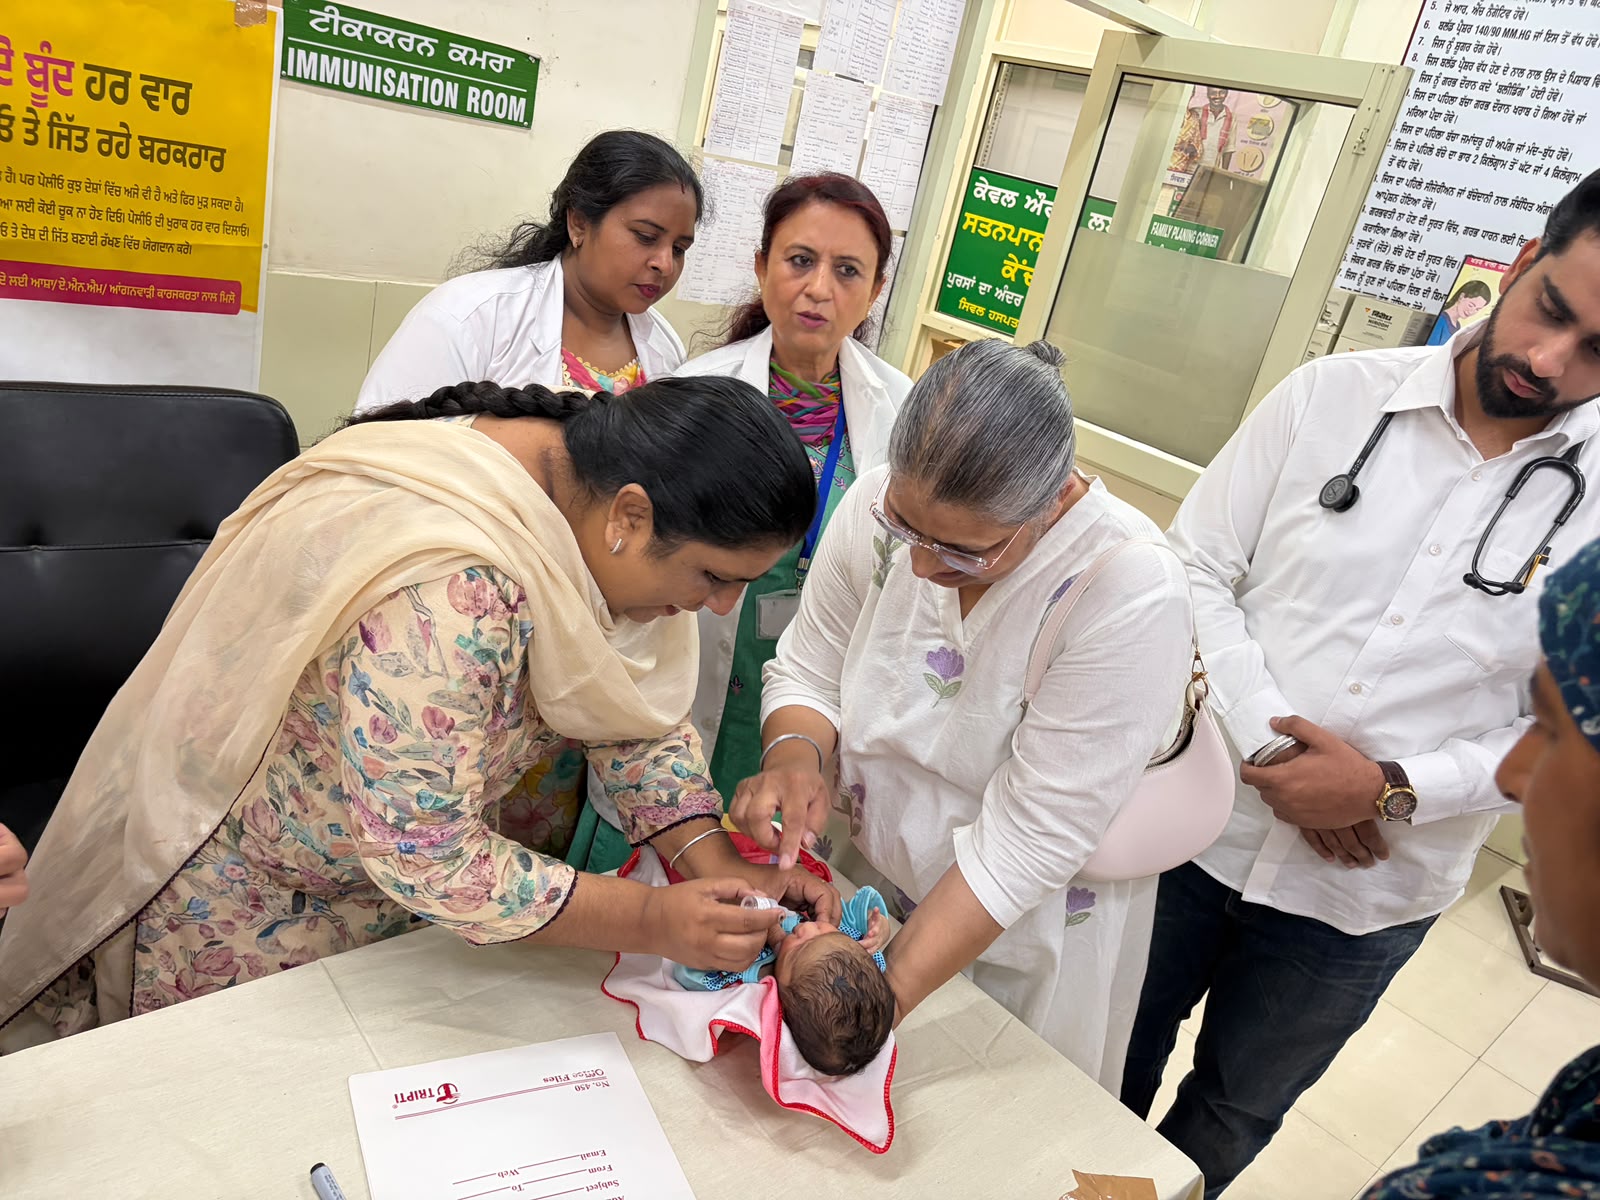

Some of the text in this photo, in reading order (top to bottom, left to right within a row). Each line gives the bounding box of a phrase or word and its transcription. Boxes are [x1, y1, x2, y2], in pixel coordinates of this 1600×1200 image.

[1430, 0, 1438, 11] 5.
[309, 5, 515, 73] ਟੀਕਾਕਰਨ ਕਮਰਾ
[1417, 36, 1425, 46] 7.
[1423, 19, 1431, 30] 6.
[1474, 24, 1502, 38] 140/90
[1501, 27, 1532, 41] MM.HG
[23, 40, 75, 108] ਬੂੰਦ
[83, 63, 132, 105] ਹਰ
[140, 74, 193, 115] ਵਾਰ
[287, 47, 459, 109] IMMUNISATION
[1411, 52, 1419, 62] 8.
[1509, 67, 1527, 78] ਨਾਲ
[1526, 69, 1543, 80] ਨਾਲ
[1427, 92, 1437, 102] ਦਾ
[22, 106, 40, 146] ਤੇ
[47, 111, 90, 153] ਜਿੱਤ
[96, 121, 131, 159] ਰਹੇ
[138, 135, 226, 173] ਬਰਕਰਾਰ
[1414, 126, 1424, 136] ਦਾ
[19, 173, 36, 186] ਪਰ
[37, 171, 65, 190] ਪੋਲੀਓ
[104, 180, 122, 197] ਵਿੱਚ
[123, 183, 140, 199] ਅਜੇ
[141, 185, 152, 201] ਵੀ
[153, 185, 162, 202] ਹੈ
[163, 188, 179, 204] ਅਤੇ
[210, 197, 233, 211] ਸਕਦਾ
[973, 176, 1020, 208] ਕੇਵਲ
[15, 197, 35, 213] ਲਈ
[37, 198, 57, 216] ਕੋਈ
[76, 206, 87, 219] ਨਾ
[88, 204, 104, 221] ਹੋਣ
[127, 209, 153, 227] ਪੋਲੀਓ
[154, 213, 165, 228] ਦੀ
[190, 219, 204, 232] ਹਰ
[205, 221, 221, 234] ਵਾਰ
[10, 222, 19, 238] ਤੇ
[38, 225, 49, 242] ਦੀ
[51, 226, 69, 243] ਜਿੱਤ
[70, 231, 98, 246] ਬਣਾਈ
[123, 234, 141, 250] ਵਿੱਚ
[962, 212, 1045, 253] ਸਤਨਪਾਨ
[1150, 221, 1173, 238] FAMILY
[1195, 231, 1219, 248] CORNER
[8, 273, 29, 287] ਲਈ
[201, 291, 218, 302] ਨਾਲ
[978, 281, 992, 295] ਦਾ
[994, 285, 1024, 307] ਅੰਦਰ
[958, 297, 1020, 329] ਸਿਵਲ ਹਸਪਤ
[542, 1074, 570, 1083] Files
[574, 1080, 610, 1091] No. 450
[497, 1149, 607, 1178] Email Web
[511, 1164, 613, 1192] From To
[586, 1179, 620, 1192] Subject
